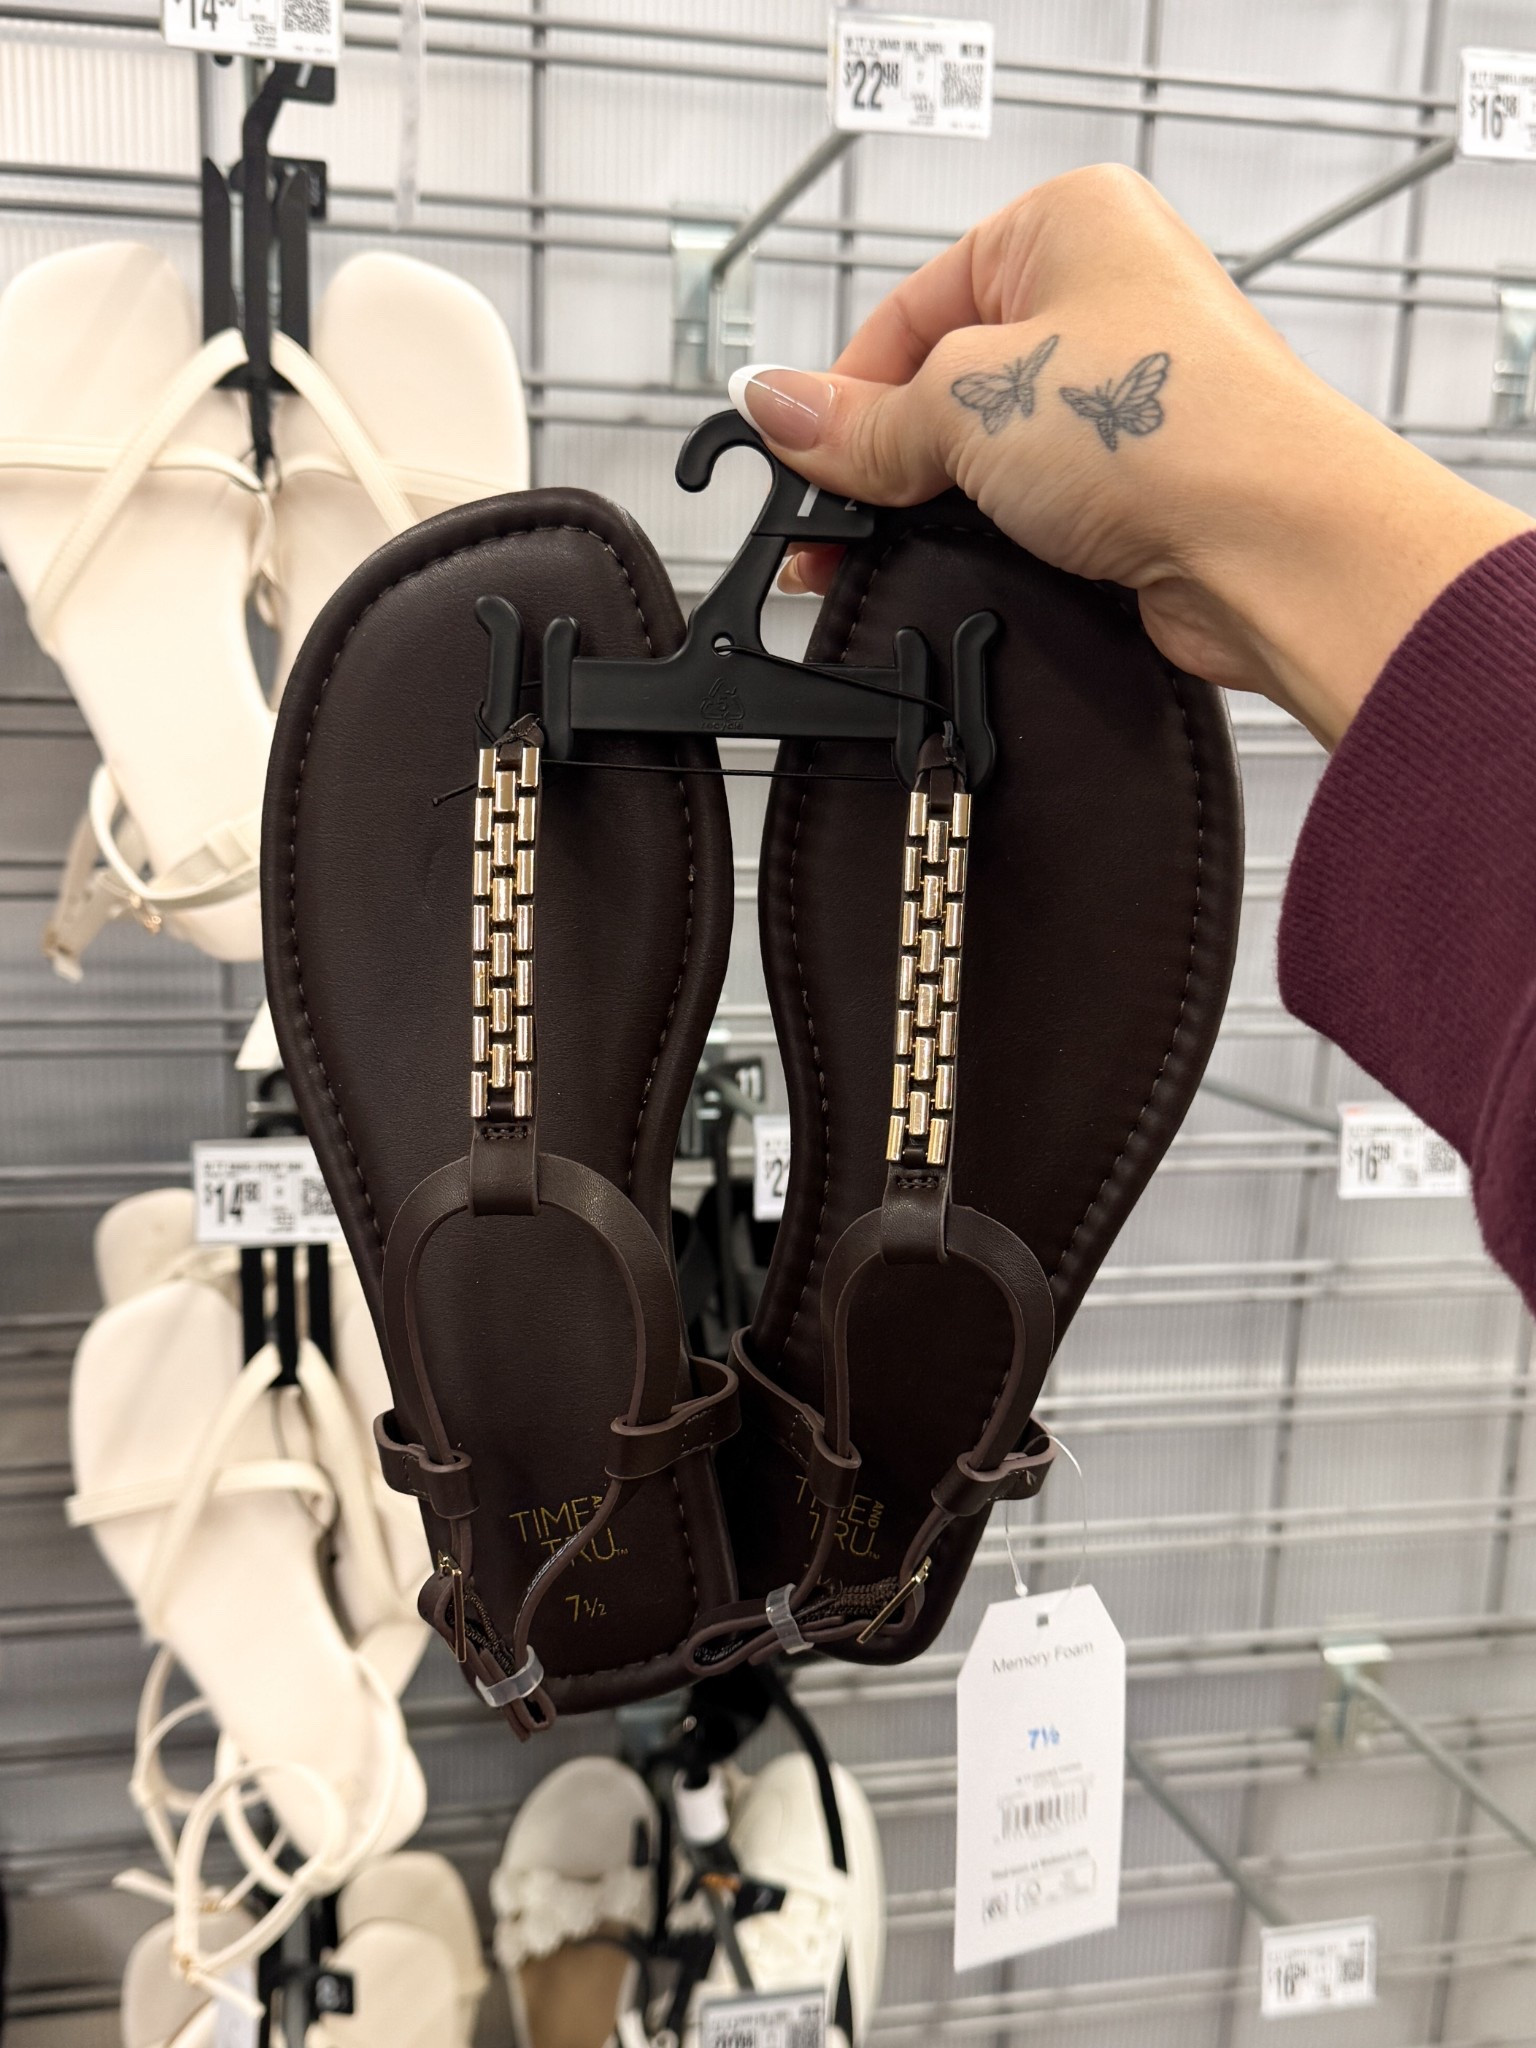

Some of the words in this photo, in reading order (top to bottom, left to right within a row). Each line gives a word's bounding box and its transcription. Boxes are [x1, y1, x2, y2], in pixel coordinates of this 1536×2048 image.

[509, 1497, 589, 1542] TIME
[992, 1651, 1051, 1674] Memory
[1054, 1641, 1094, 1662] Foam
